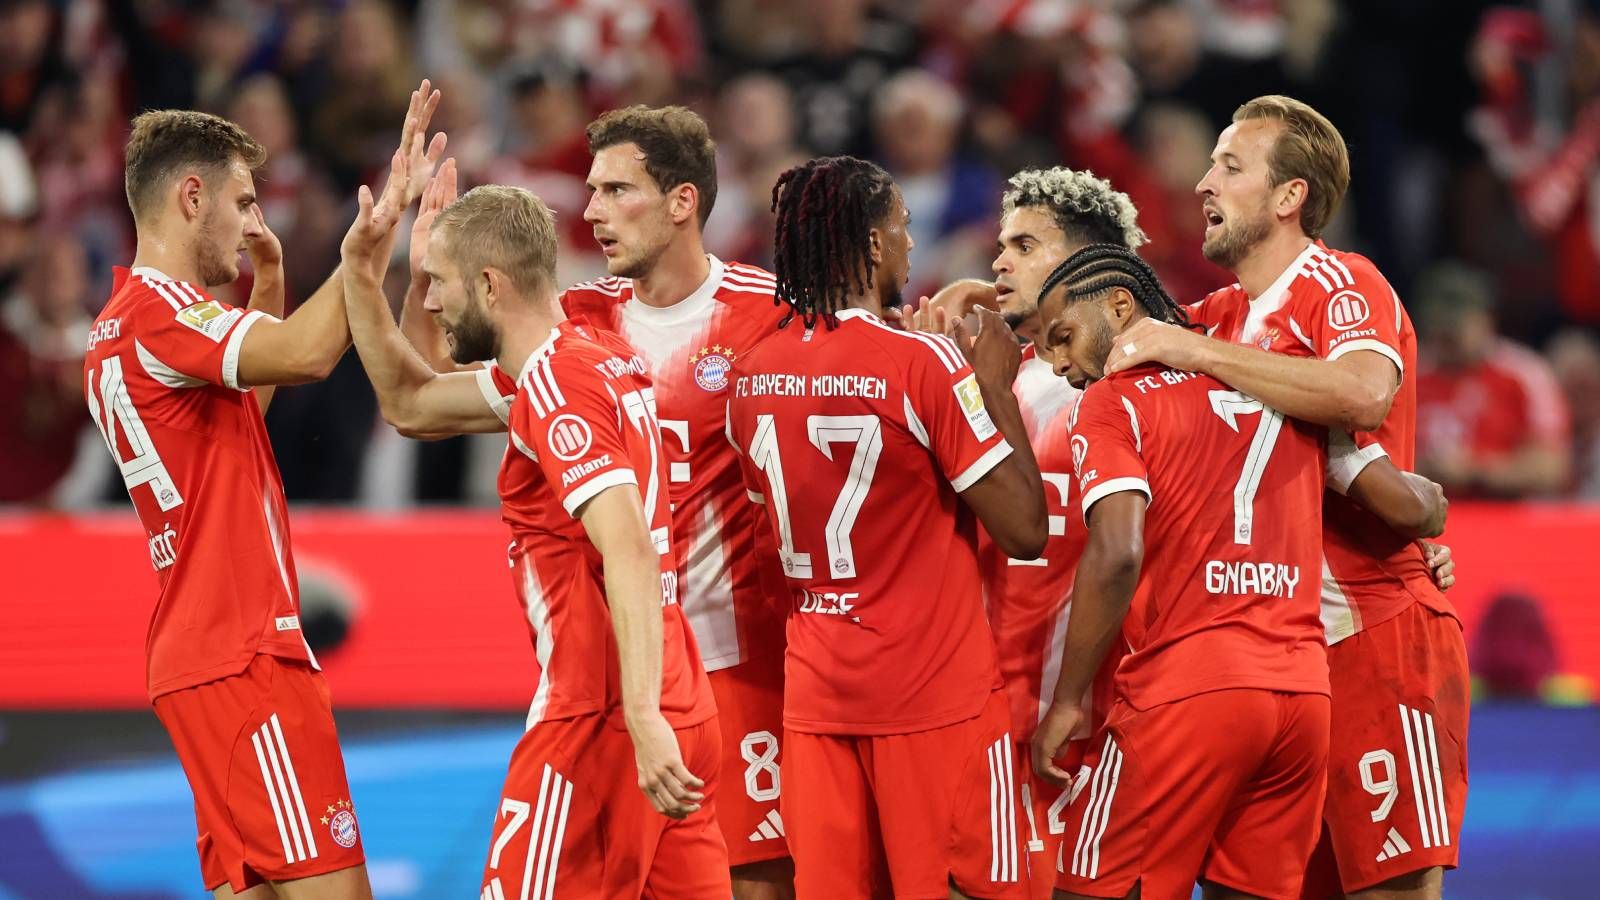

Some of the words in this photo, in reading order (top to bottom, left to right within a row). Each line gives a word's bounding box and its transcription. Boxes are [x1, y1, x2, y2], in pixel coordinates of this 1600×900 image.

[735, 375, 749, 398] FC
[752, 374, 806, 397] BAYERN
[811, 375, 887, 399] MÜNCHEN
[1134, 375, 1162, 394] FC
[561, 454, 613, 488] Allianz
[1207, 389, 1285, 546] 7
[749, 414, 884, 580] 17
[1205, 560, 1300, 599] GNABRY
[740, 730, 781, 802] 8
[1358, 748, 1399, 823] 9
